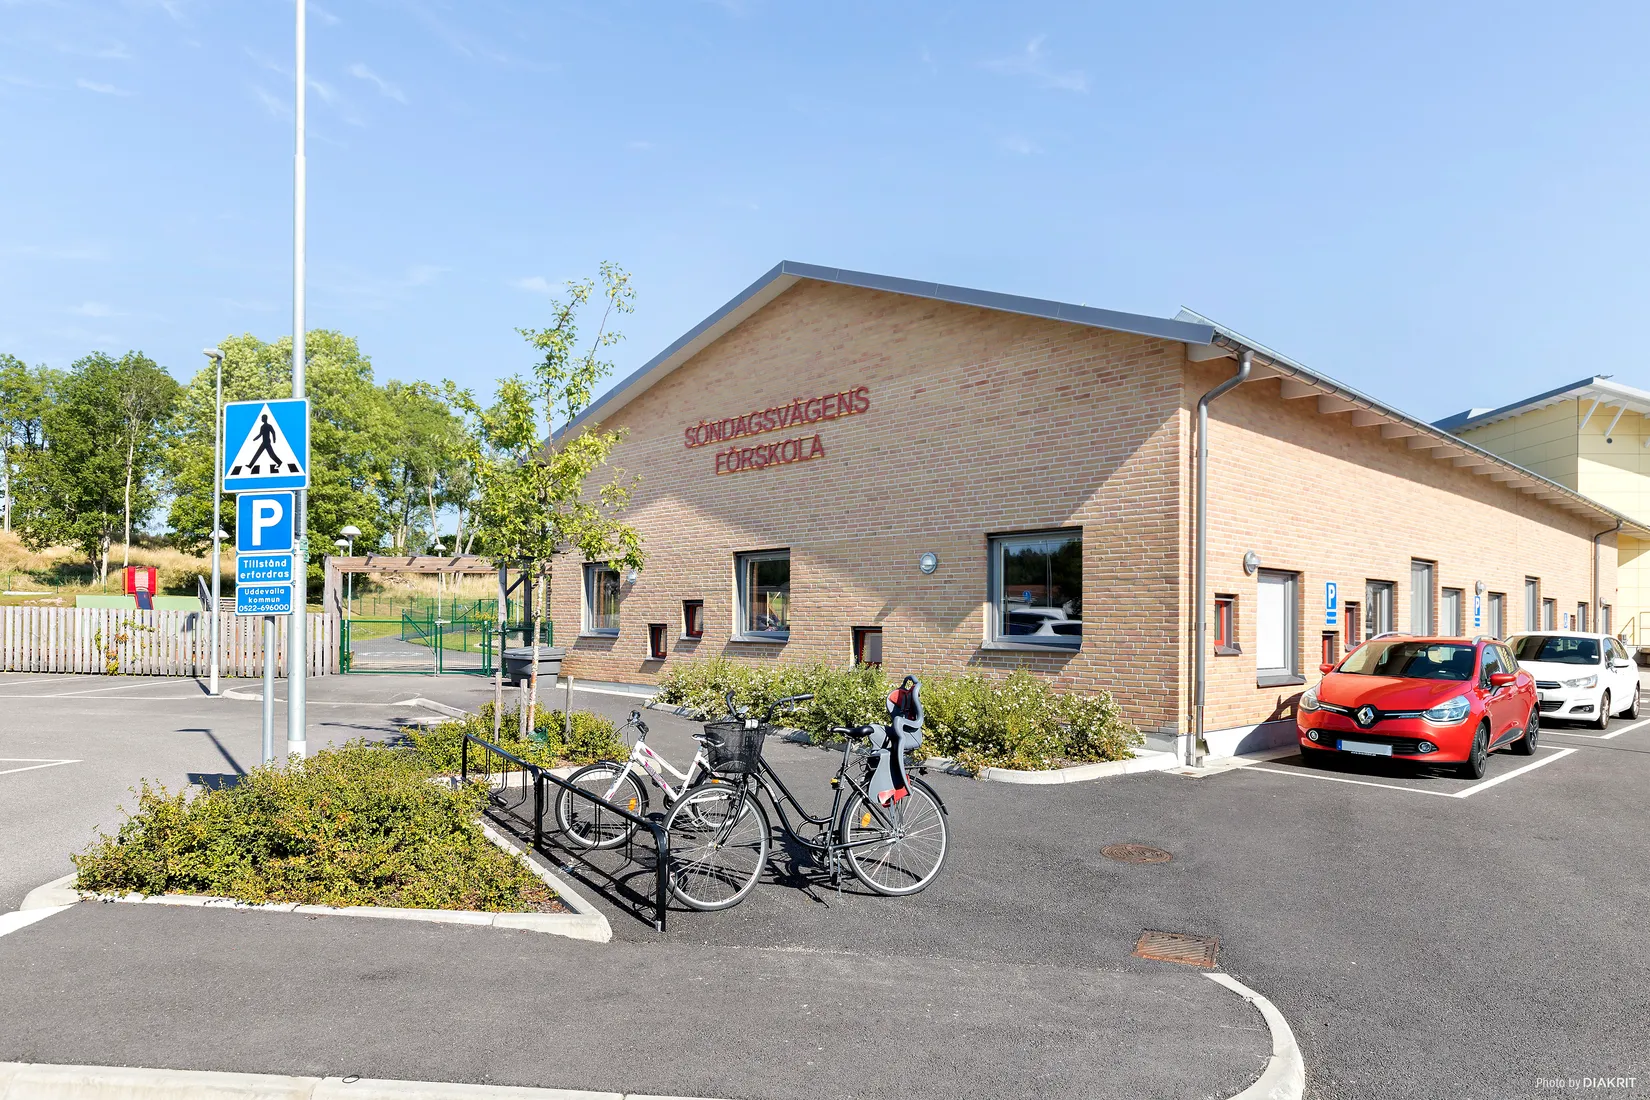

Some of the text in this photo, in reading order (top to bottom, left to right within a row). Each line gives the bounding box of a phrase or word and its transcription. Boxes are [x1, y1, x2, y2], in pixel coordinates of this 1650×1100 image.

[684, 386, 870, 449] SÖNDAGSVÄGENS
[715, 434, 825, 475] FÖRSKOLA
[252, 498, 283, 546] P
[240, 569, 290, 580] erfordras
[243, 558, 287, 569] Tillstånd
[1328, 584, 1335, 607] P
[238, 603, 290, 612] 0522-696000
